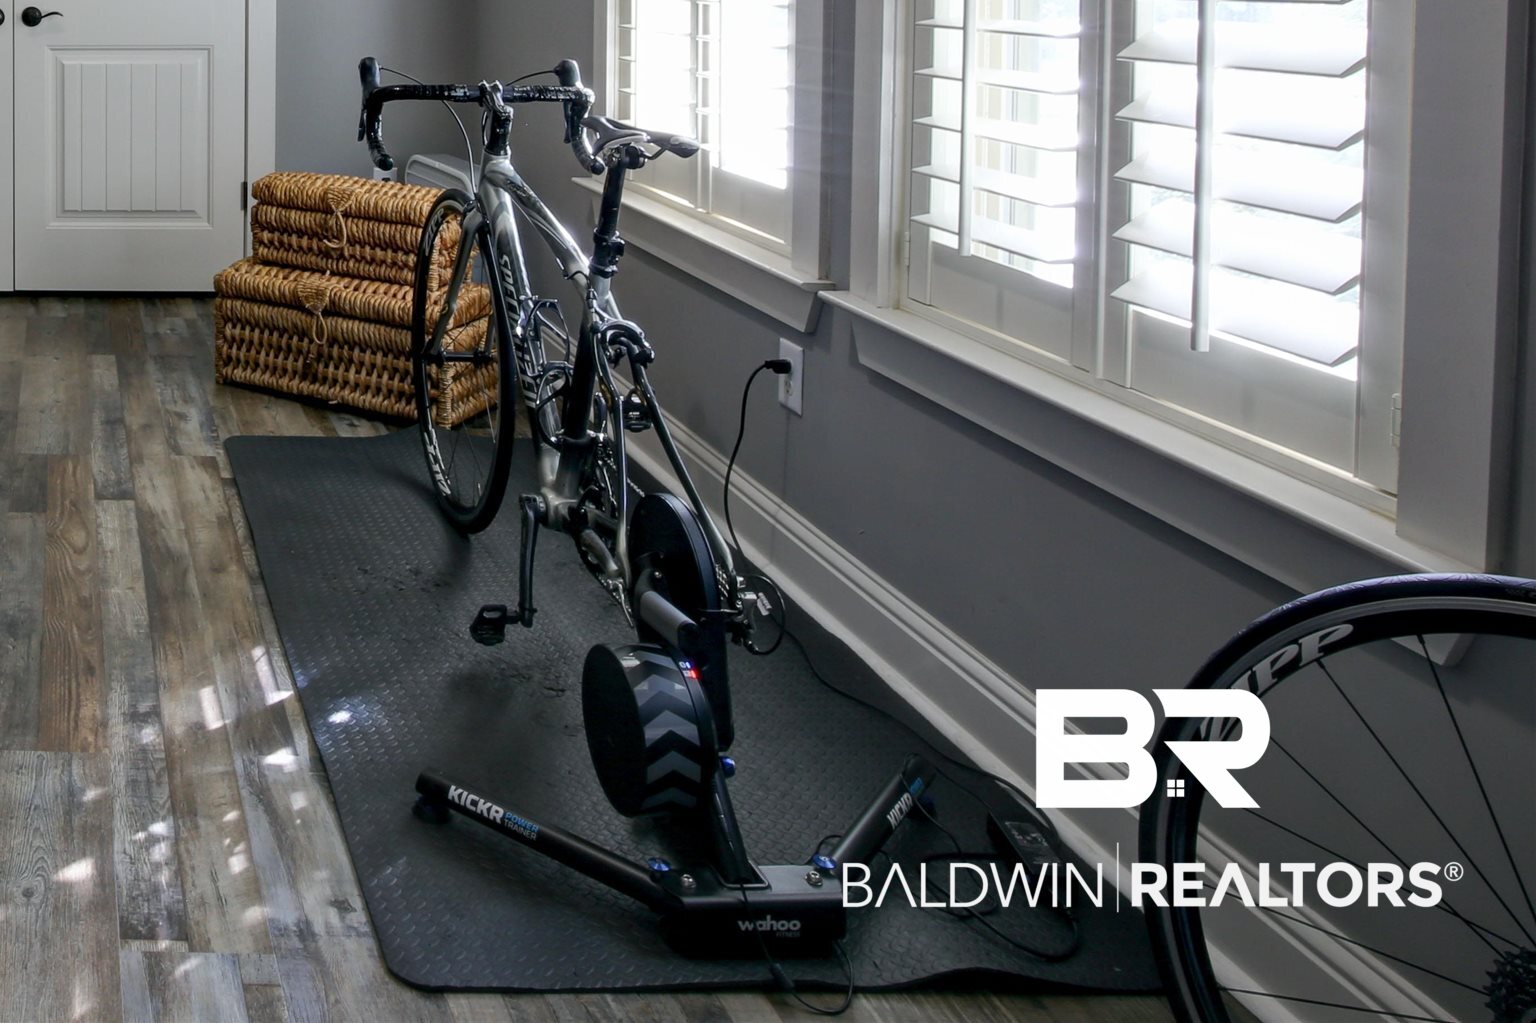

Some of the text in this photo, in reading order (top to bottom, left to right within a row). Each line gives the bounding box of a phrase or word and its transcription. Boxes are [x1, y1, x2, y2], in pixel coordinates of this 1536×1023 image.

[448, 784, 505, 825] KICKR
[886, 792, 913, 830] KICKR
[504, 811, 540, 834] POWER
[504, 818, 538, 842] TRAINER
[736, 914, 802, 932] wahoo
